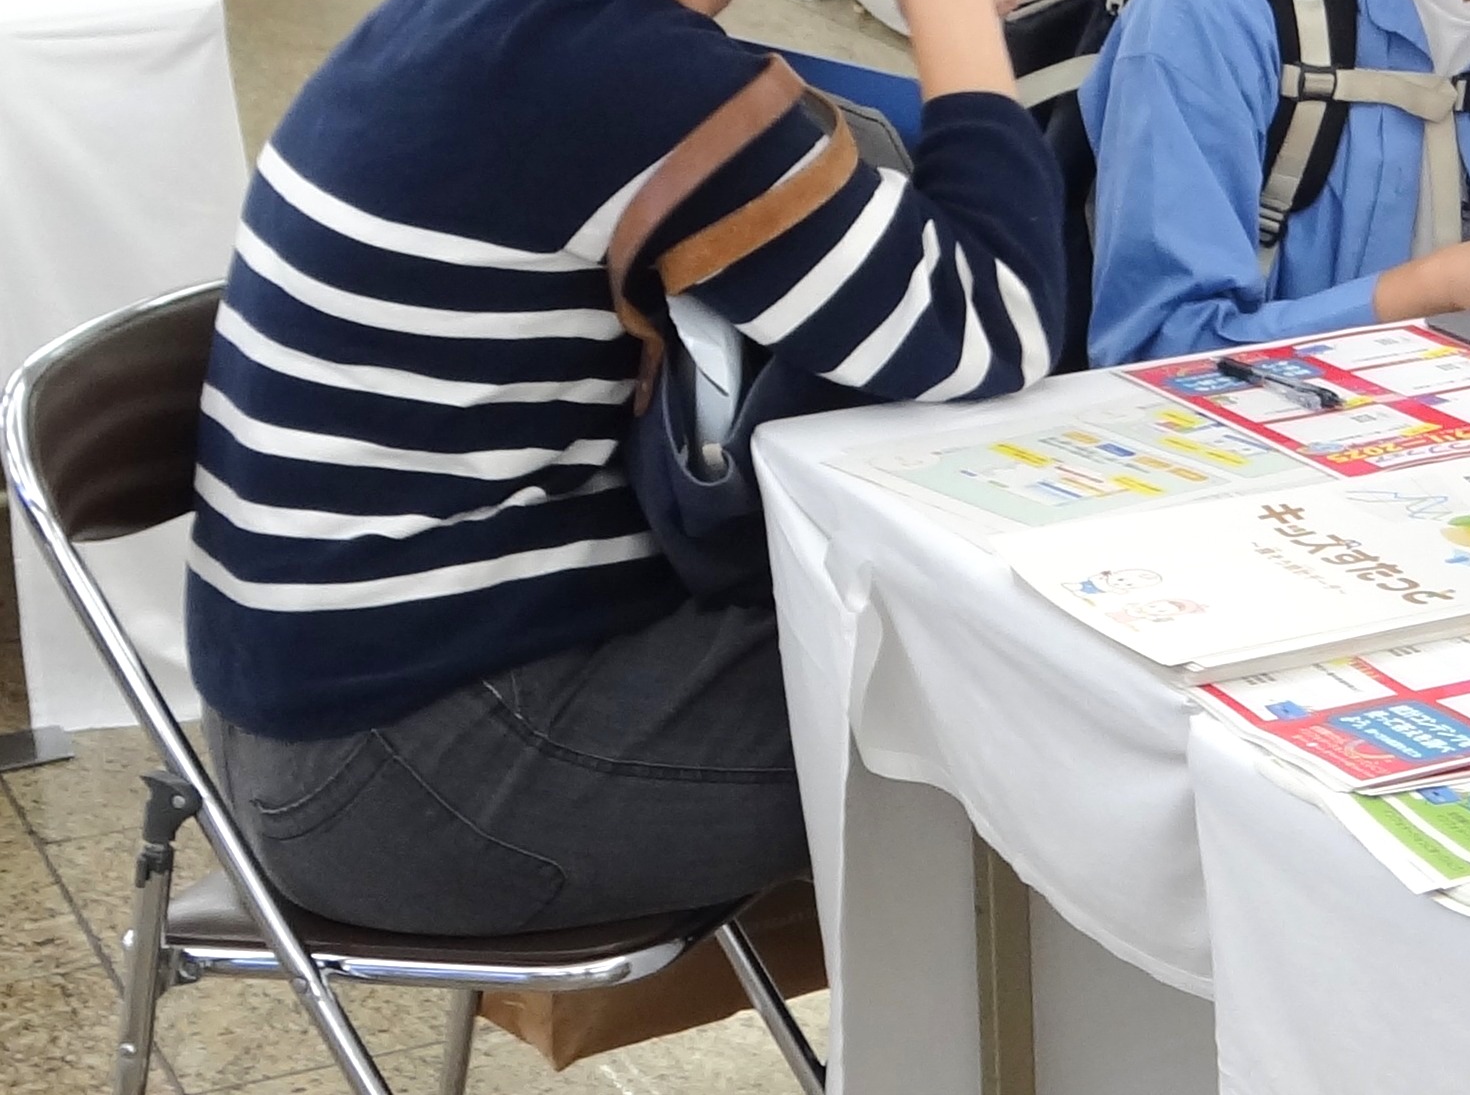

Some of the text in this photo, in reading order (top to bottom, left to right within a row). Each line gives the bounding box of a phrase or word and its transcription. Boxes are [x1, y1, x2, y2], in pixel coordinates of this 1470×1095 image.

[1258, 503, 1455, 604] キッズすたっと
